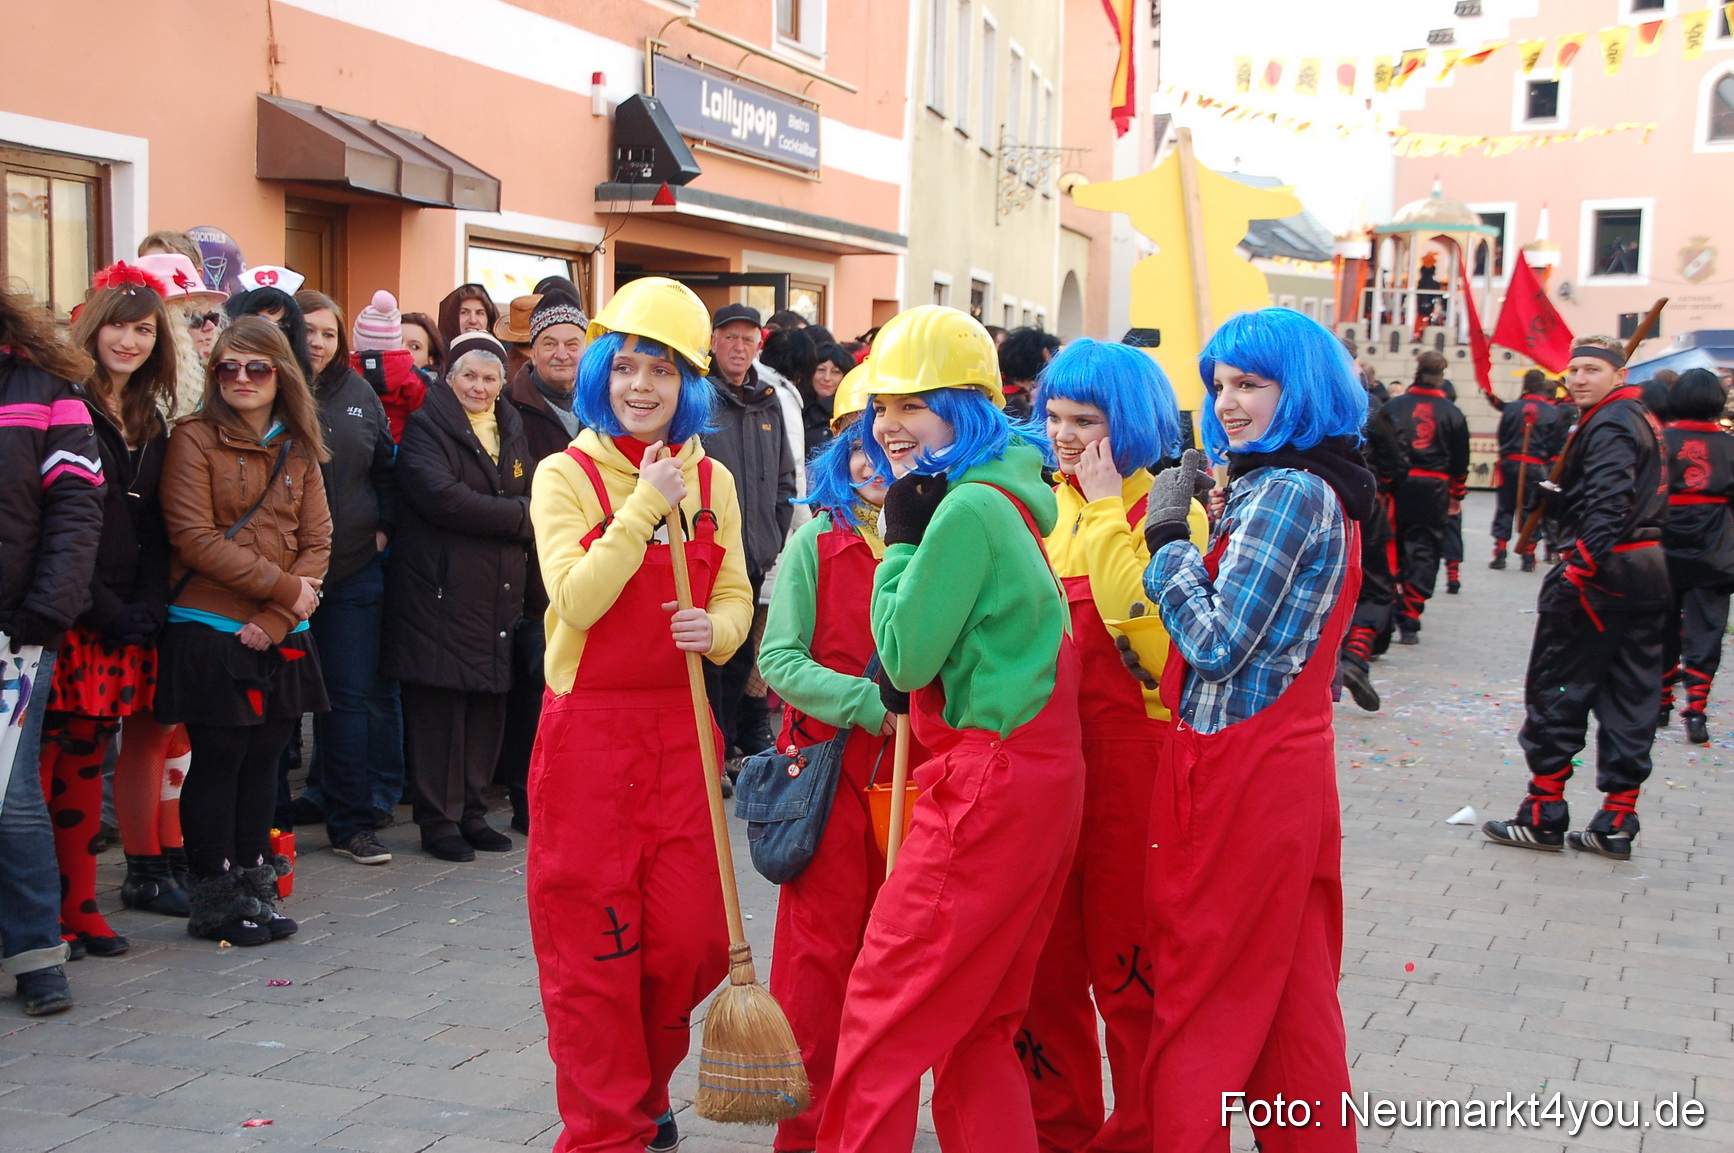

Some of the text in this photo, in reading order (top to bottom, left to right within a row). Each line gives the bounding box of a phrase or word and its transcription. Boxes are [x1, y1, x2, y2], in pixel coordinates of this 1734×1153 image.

[701, 79, 778, 147] Lollypop
[788, 113, 810, 134] Bistro
[593, 905, 640, 962] 土
[1113, 944, 1155, 999] 火
